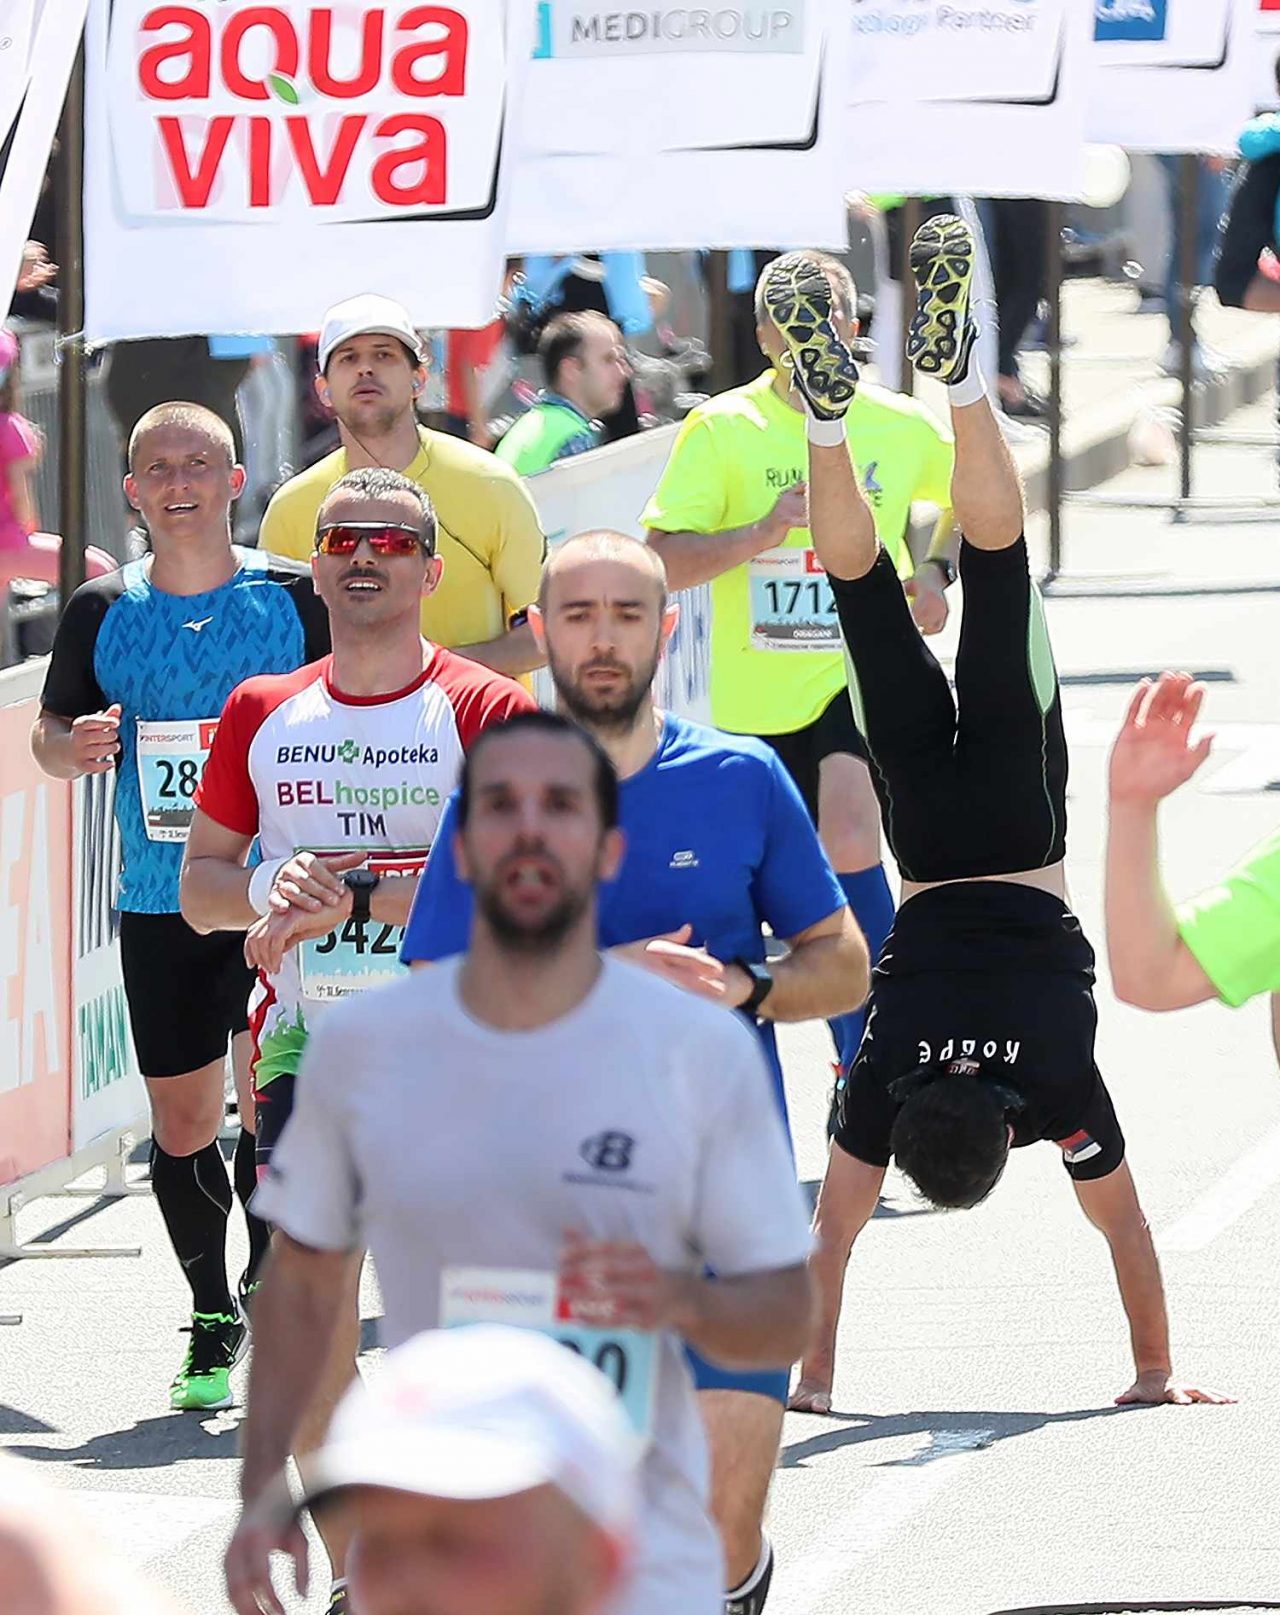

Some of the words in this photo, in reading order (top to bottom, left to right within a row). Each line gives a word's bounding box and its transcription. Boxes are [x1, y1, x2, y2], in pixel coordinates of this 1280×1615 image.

[571, 9, 794, 42] MEDIGROUP
[277, 745, 335, 764] BENU
[363, 743, 438, 768] Apoteka
[277, 780, 440, 810] BELhospice
[337, 812, 387, 837] TIM
